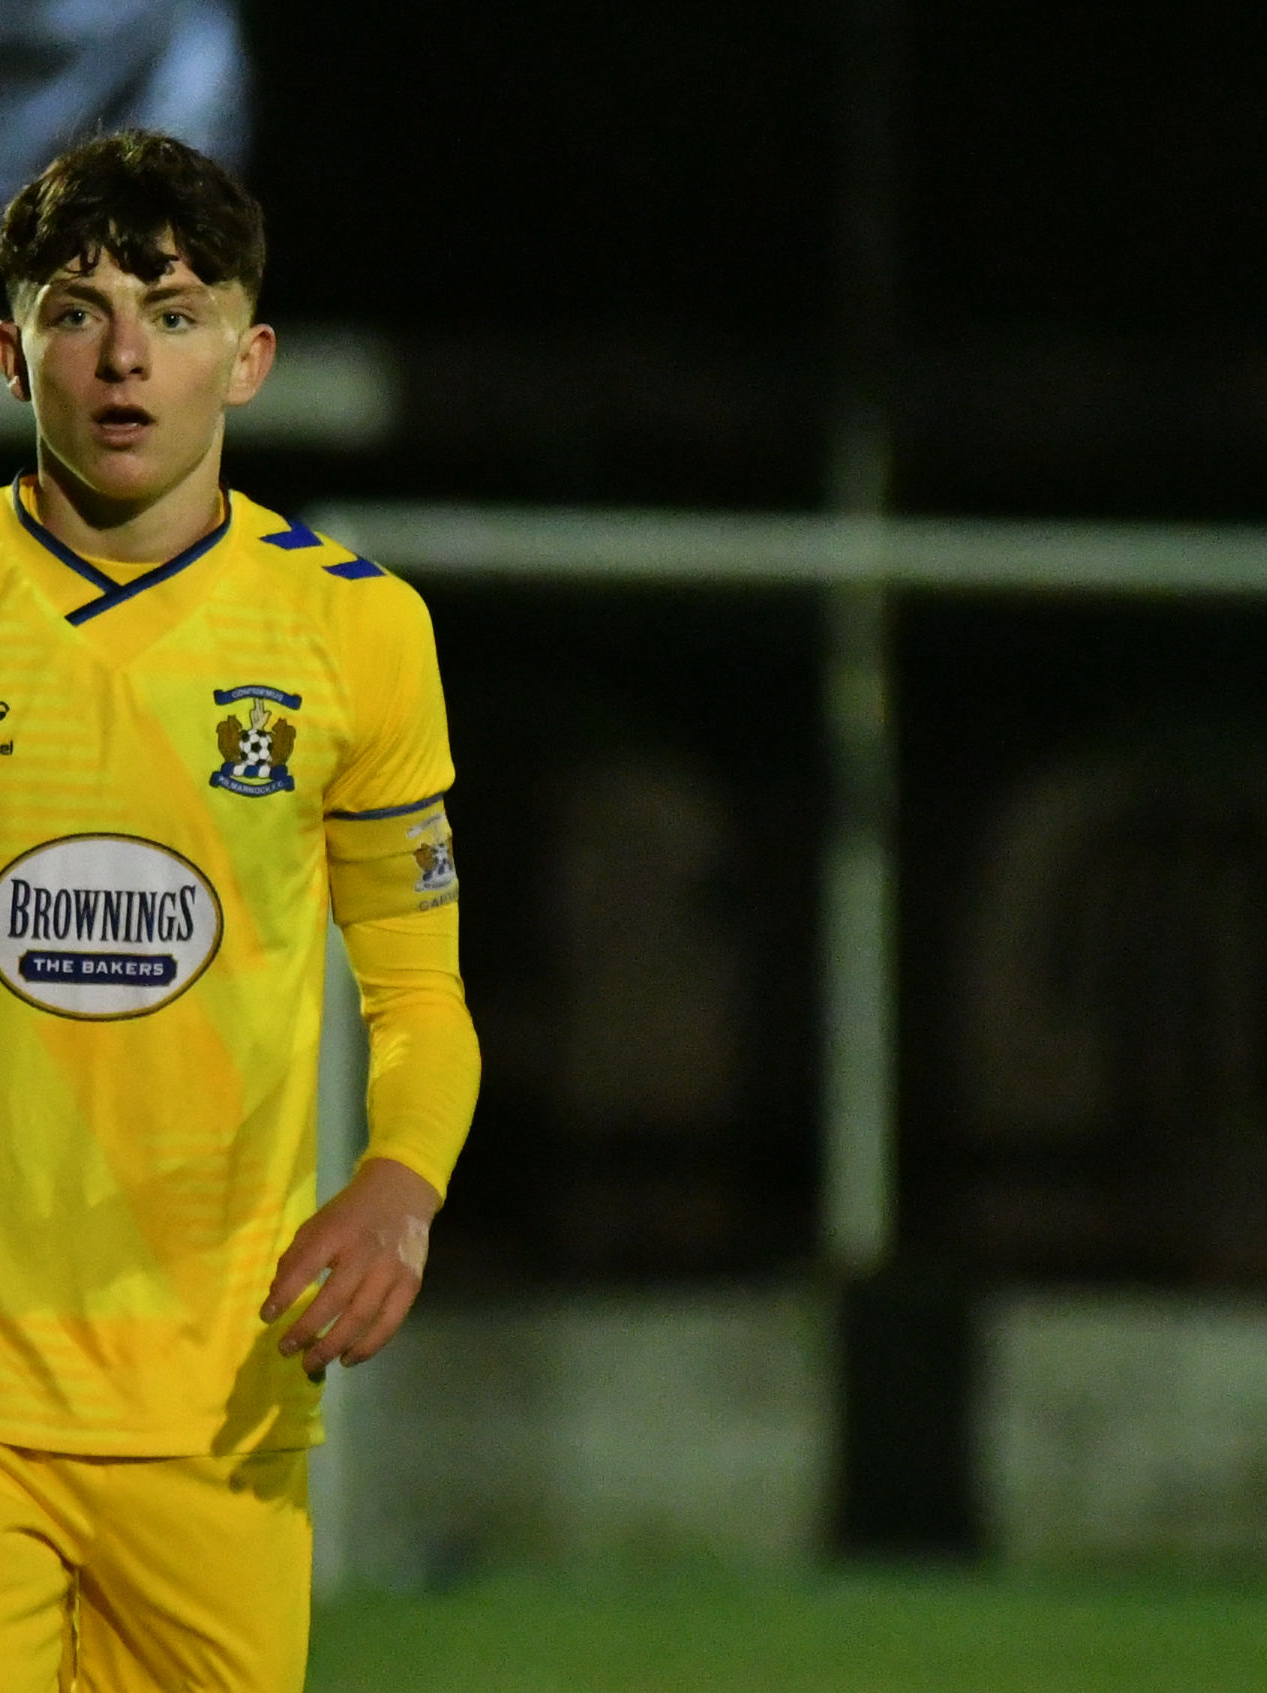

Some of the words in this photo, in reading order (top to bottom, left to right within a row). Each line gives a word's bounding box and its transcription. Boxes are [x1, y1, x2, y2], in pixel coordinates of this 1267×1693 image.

[7, 878, 197, 944] BROWNINGS
[33, 957, 75, 974] THE
[82, 960, 164, 977] BAKERS
